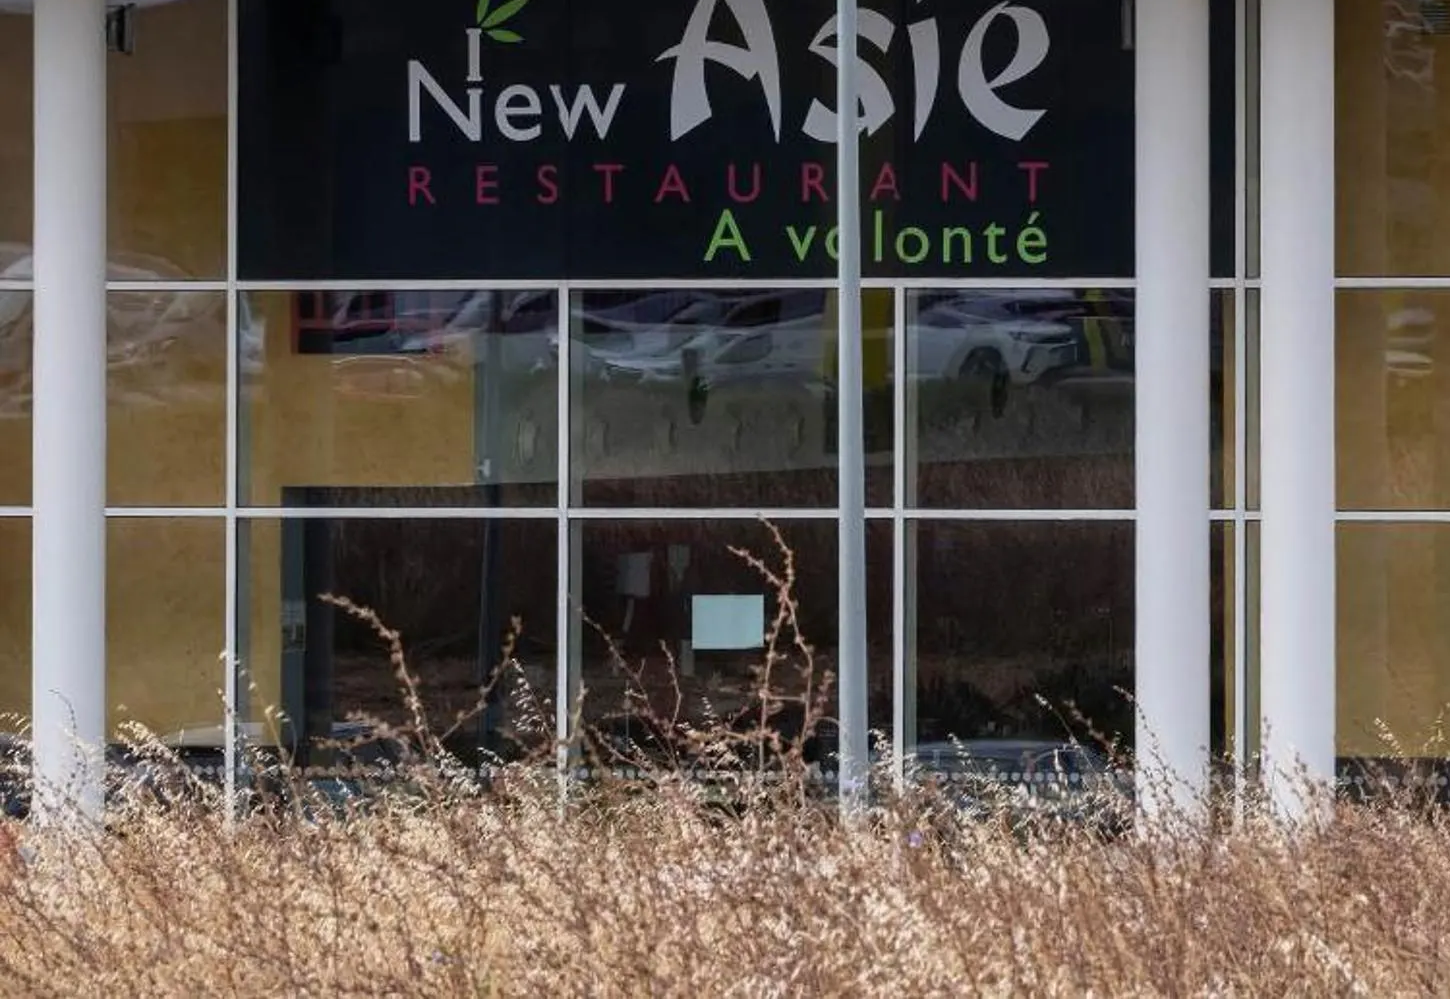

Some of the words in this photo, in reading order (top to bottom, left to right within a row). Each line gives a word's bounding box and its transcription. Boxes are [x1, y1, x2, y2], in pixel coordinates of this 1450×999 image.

[409, 58, 626, 142] New
[408, 161, 1050, 204] RESTAURANT
[703, 208, 750, 262] A
